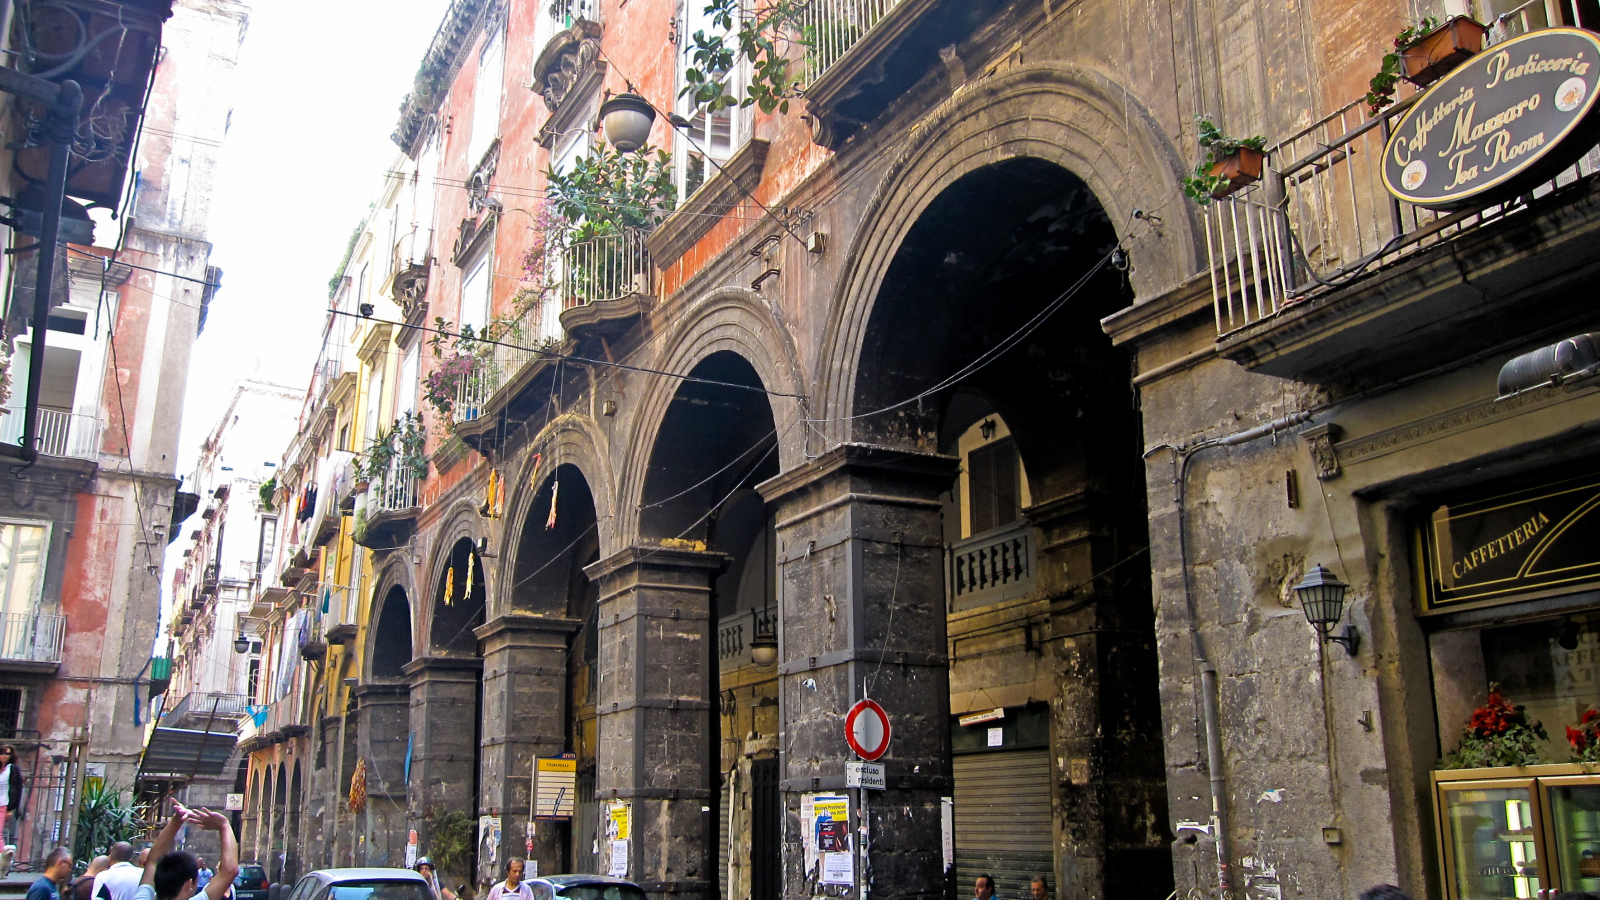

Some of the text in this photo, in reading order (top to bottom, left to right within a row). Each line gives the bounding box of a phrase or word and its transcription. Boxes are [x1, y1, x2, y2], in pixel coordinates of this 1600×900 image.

[1486, 50, 1590, 89] Pasticceria
[1438, 93, 1541, 157] Mazzaro
[1444, 129, 1545, 191] Tea Room
[1452, 511, 1550, 579] CAFFETTERIA
[855, 766, 880, 775] escluso
[857, 777, 884, 785] residenti
